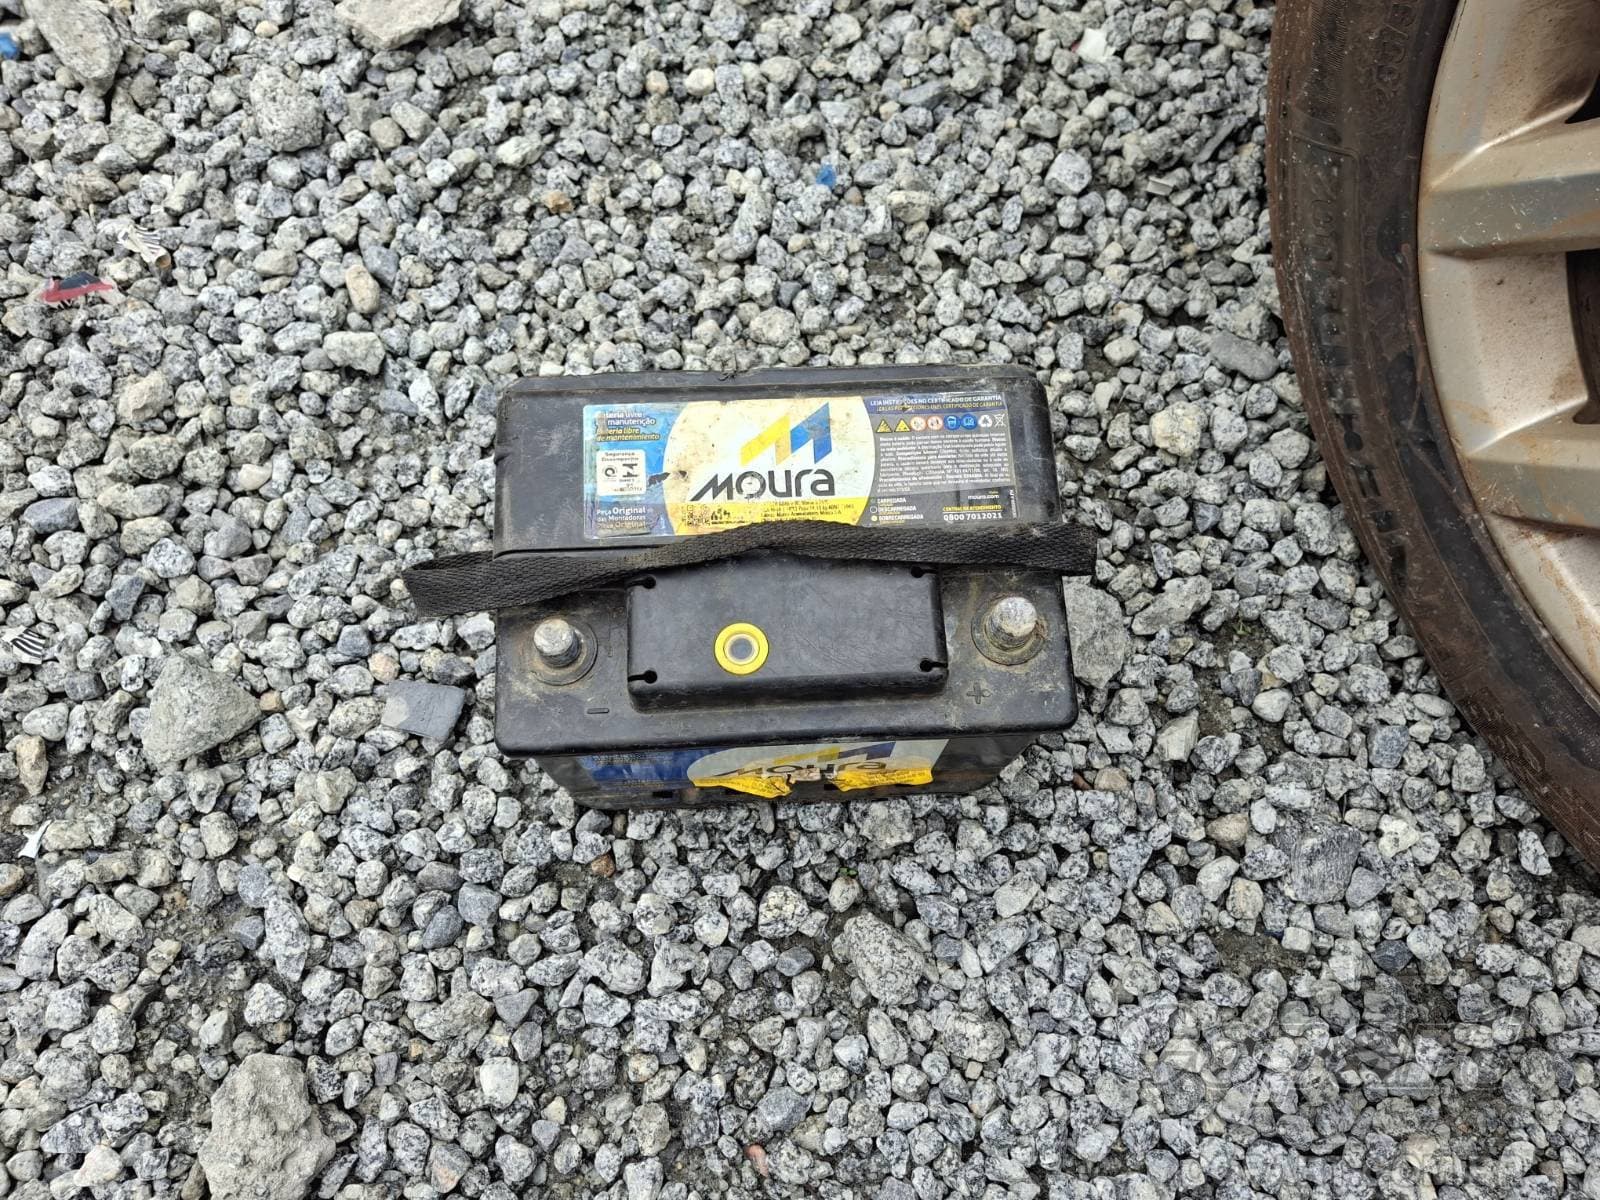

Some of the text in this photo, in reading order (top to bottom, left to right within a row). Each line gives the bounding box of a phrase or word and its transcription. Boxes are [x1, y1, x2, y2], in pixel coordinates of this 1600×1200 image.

[607, 417, 656, 427] manutenção
[612, 506, 646, 516] Original
[943, 512, 1003, 521] 0800 7012021
